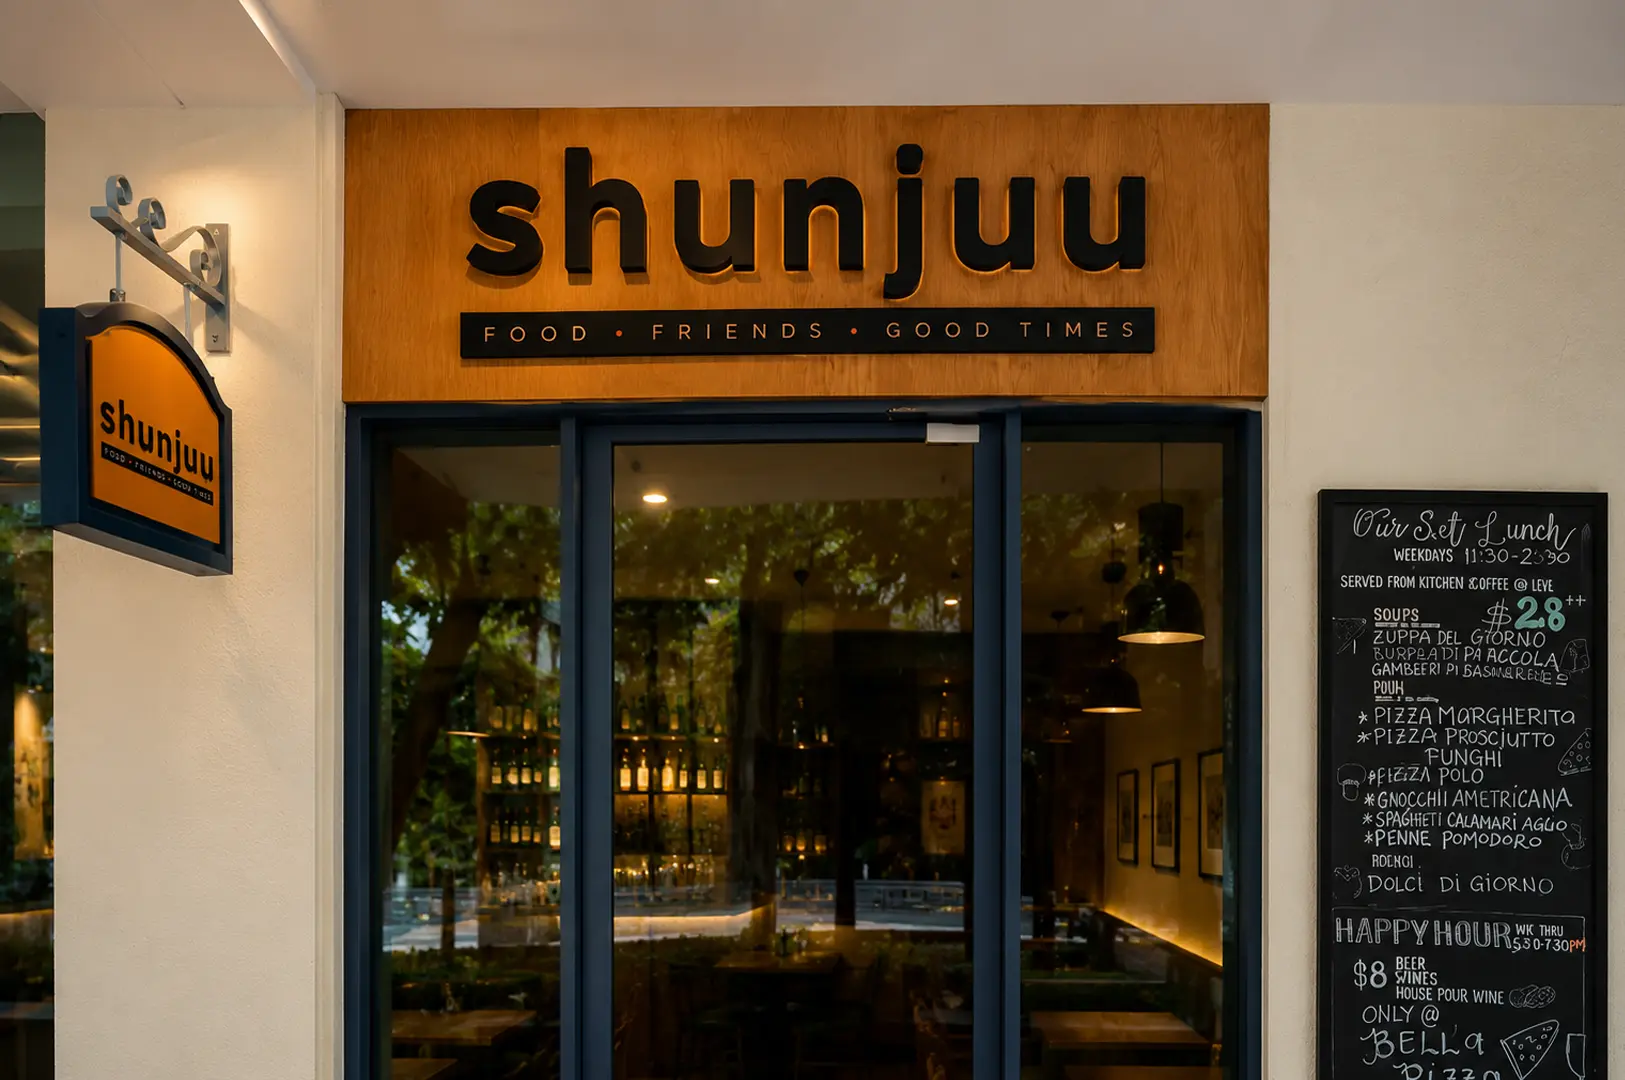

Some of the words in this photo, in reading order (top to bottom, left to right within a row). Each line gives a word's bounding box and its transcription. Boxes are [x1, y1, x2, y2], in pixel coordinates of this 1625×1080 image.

[467, 143, 1147, 300] shunjuu
[484, 325, 587, 342] FOOD
[652, 323, 822, 340] FRIENDS
[886, 322, 989, 338] GOOD
[1020, 322, 1134, 338] TIMES
[100, 399, 214, 483] shunjuu
[1353, 508, 1409, 537] Our
[1413, 509, 1467, 547] Set
[1475, 510, 1576, 550] Lunch
[1394, 548, 1453, 562] WEEKDAYS
[1340, 575, 1383, 589] SERVED
[1387, 575, 1415, 589] FROM
[1419, 575, 1464, 589] KITCHEN
[1373, 607, 1419, 622] SOUPS
[1373, 630, 1431, 645] ZUPPA
[1437, 630, 1462, 645] DEL
[1375, 707, 1432, 725] PIZZA
[1374, 728, 1437, 745] PIZZA
[1438, 767, 1484, 786] POLO
[1375, 829, 1431, 847] PENNE
[1442, 831, 1542, 850] POMODORO
[1335, 917, 1429, 945] HAPPY
[1433, 920, 1512, 949] HOUR
[1539, 924, 1564, 937] THRU
[1396, 956, 1426, 970] BEER
[1353, 958, 1387, 991] $8
[1396, 986, 1433, 1001] HOUSE
[1438, 988, 1468, 1003] POUR
[1473, 989, 1505, 1005] WINE
[1362, 1004, 1414, 1024] ONLY
[1421, 1004, 1440, 1028] @
